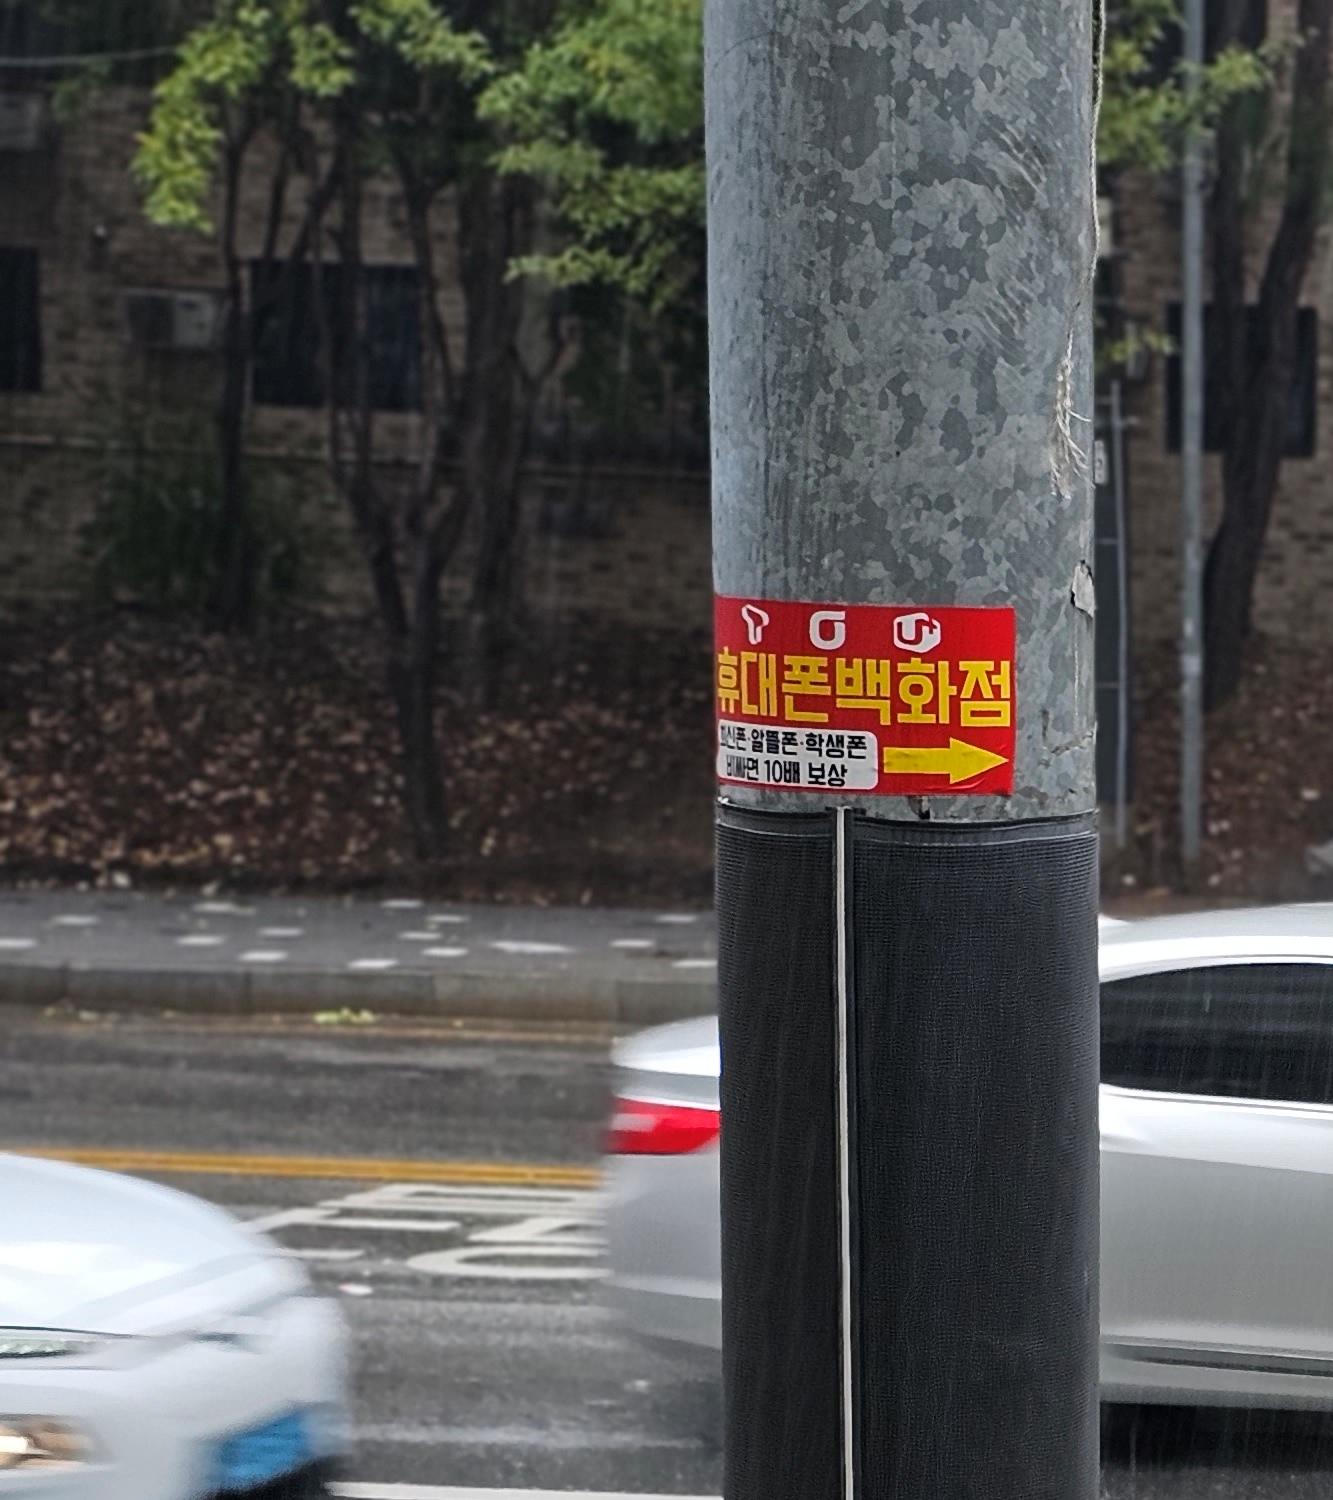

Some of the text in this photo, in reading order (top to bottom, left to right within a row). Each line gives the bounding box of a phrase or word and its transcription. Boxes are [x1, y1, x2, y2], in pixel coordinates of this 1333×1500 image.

[716, 646, 1012, 728] 휴대폰백화점
[764, 759, 801, 784] 10배
[807, 761, 848, 788] 보상
